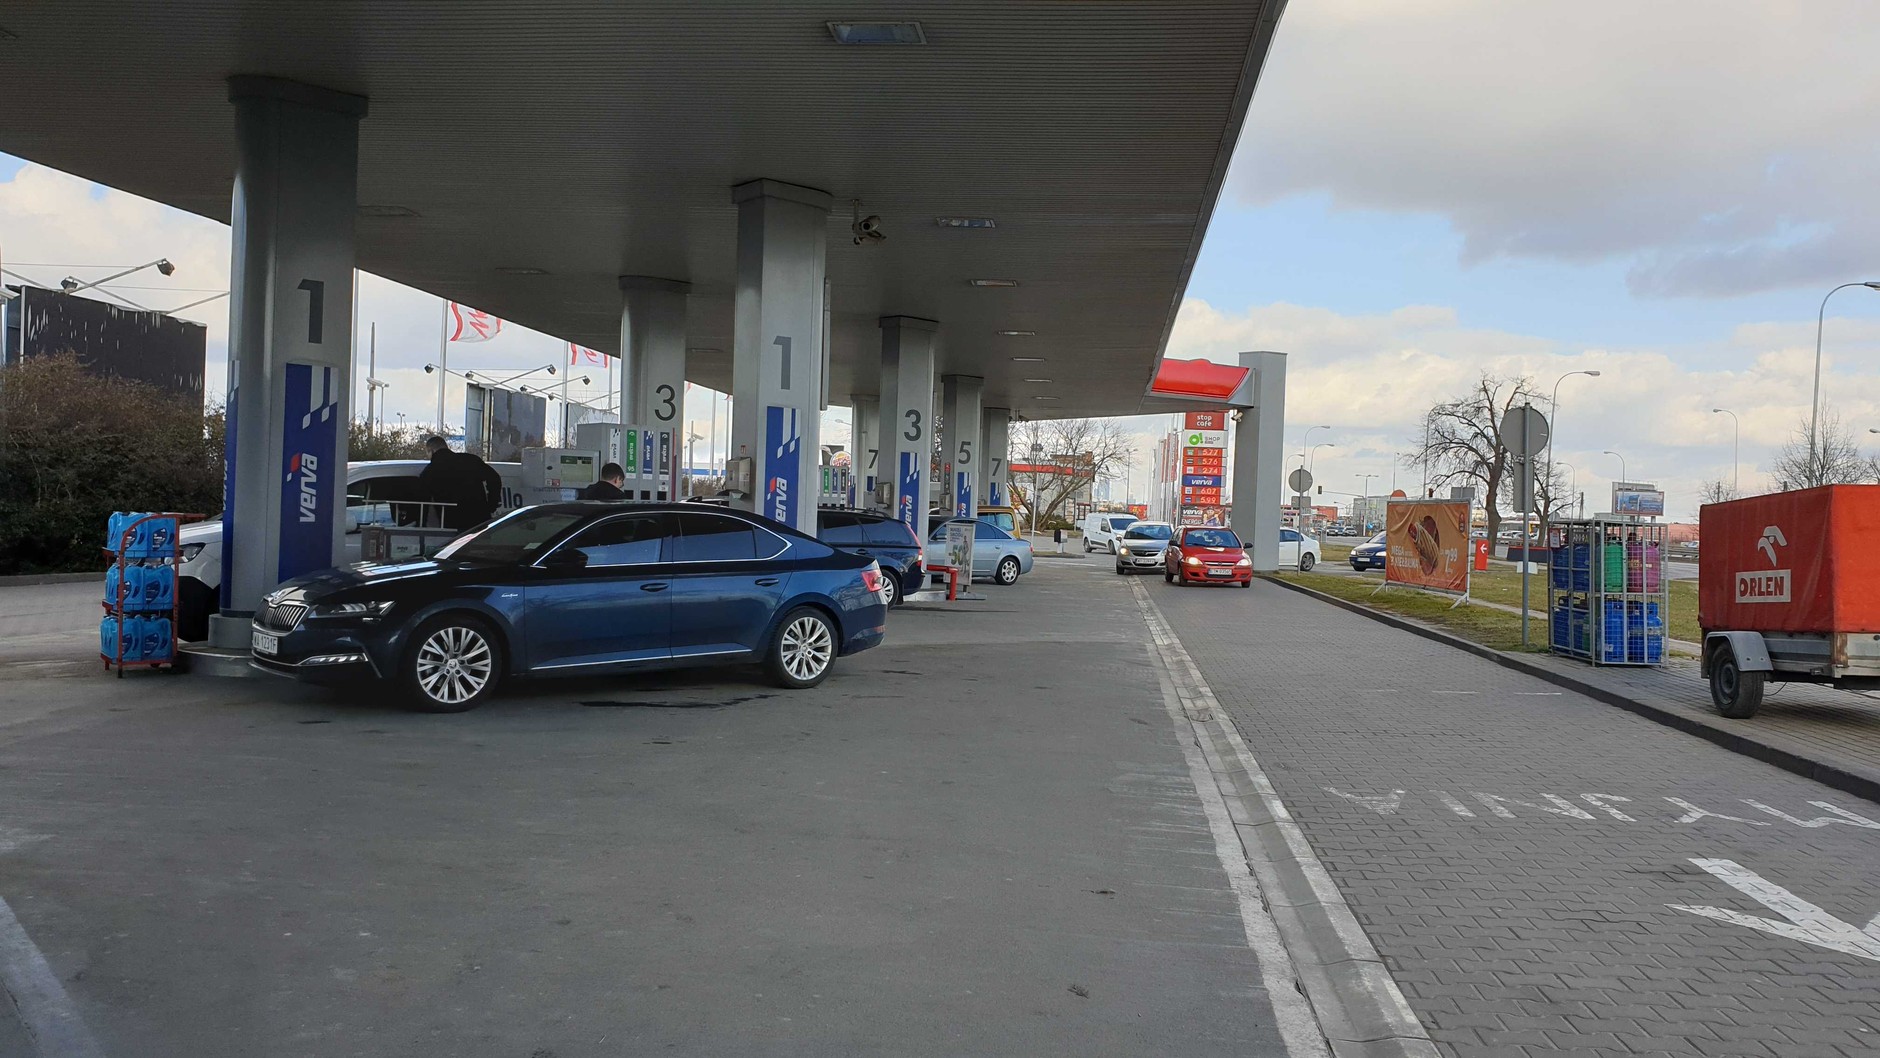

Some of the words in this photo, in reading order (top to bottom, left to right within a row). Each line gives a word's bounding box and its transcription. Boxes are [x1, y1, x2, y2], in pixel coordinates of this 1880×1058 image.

[297, 278, 324, 344] 1
[773, 335, 792, 390] 1
[654, 384, 677, 421] 3
[903, 409, 922, 442] 3
[868, 449, 879, 469] 7
[958, 441, 971, 465] 5
[991, 457, 1002, 477] 7
[299, 452, 318, 522] verva
[1739, 576, 1785, 597] ORLEN
